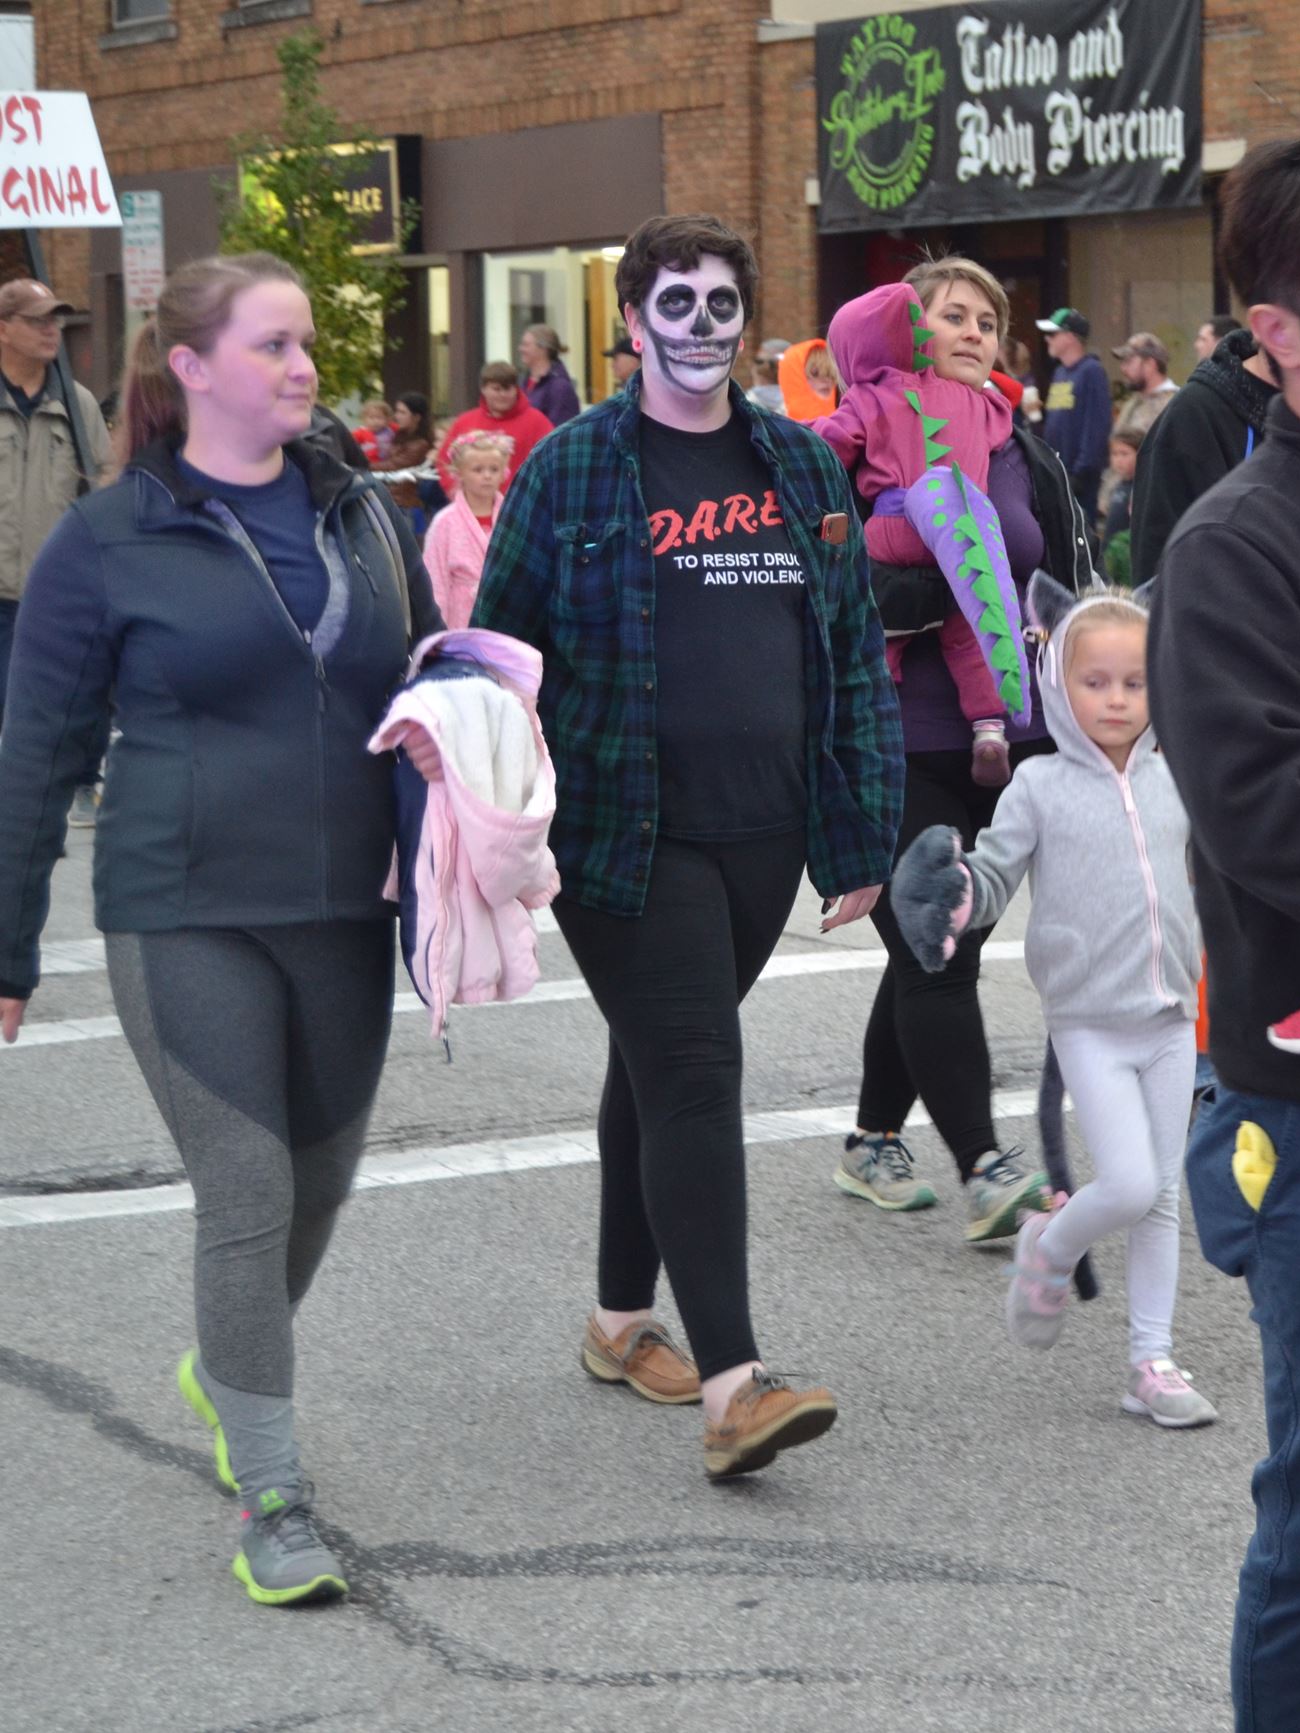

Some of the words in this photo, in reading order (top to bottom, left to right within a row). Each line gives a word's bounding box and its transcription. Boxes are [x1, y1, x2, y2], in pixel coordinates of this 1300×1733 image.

[956, 15, 1059, 93] Tattoo
[1069, 9, 1124, 80] and
[0, 96, 43, 146] ST
[956, 98, 1036, 190] Body
[1045, 88, 1186, 176] Piercing
[674, 556, 698, 570] TO
[703, 553, 759, 568] RESIST
[704, 571, 739, 585] AND
